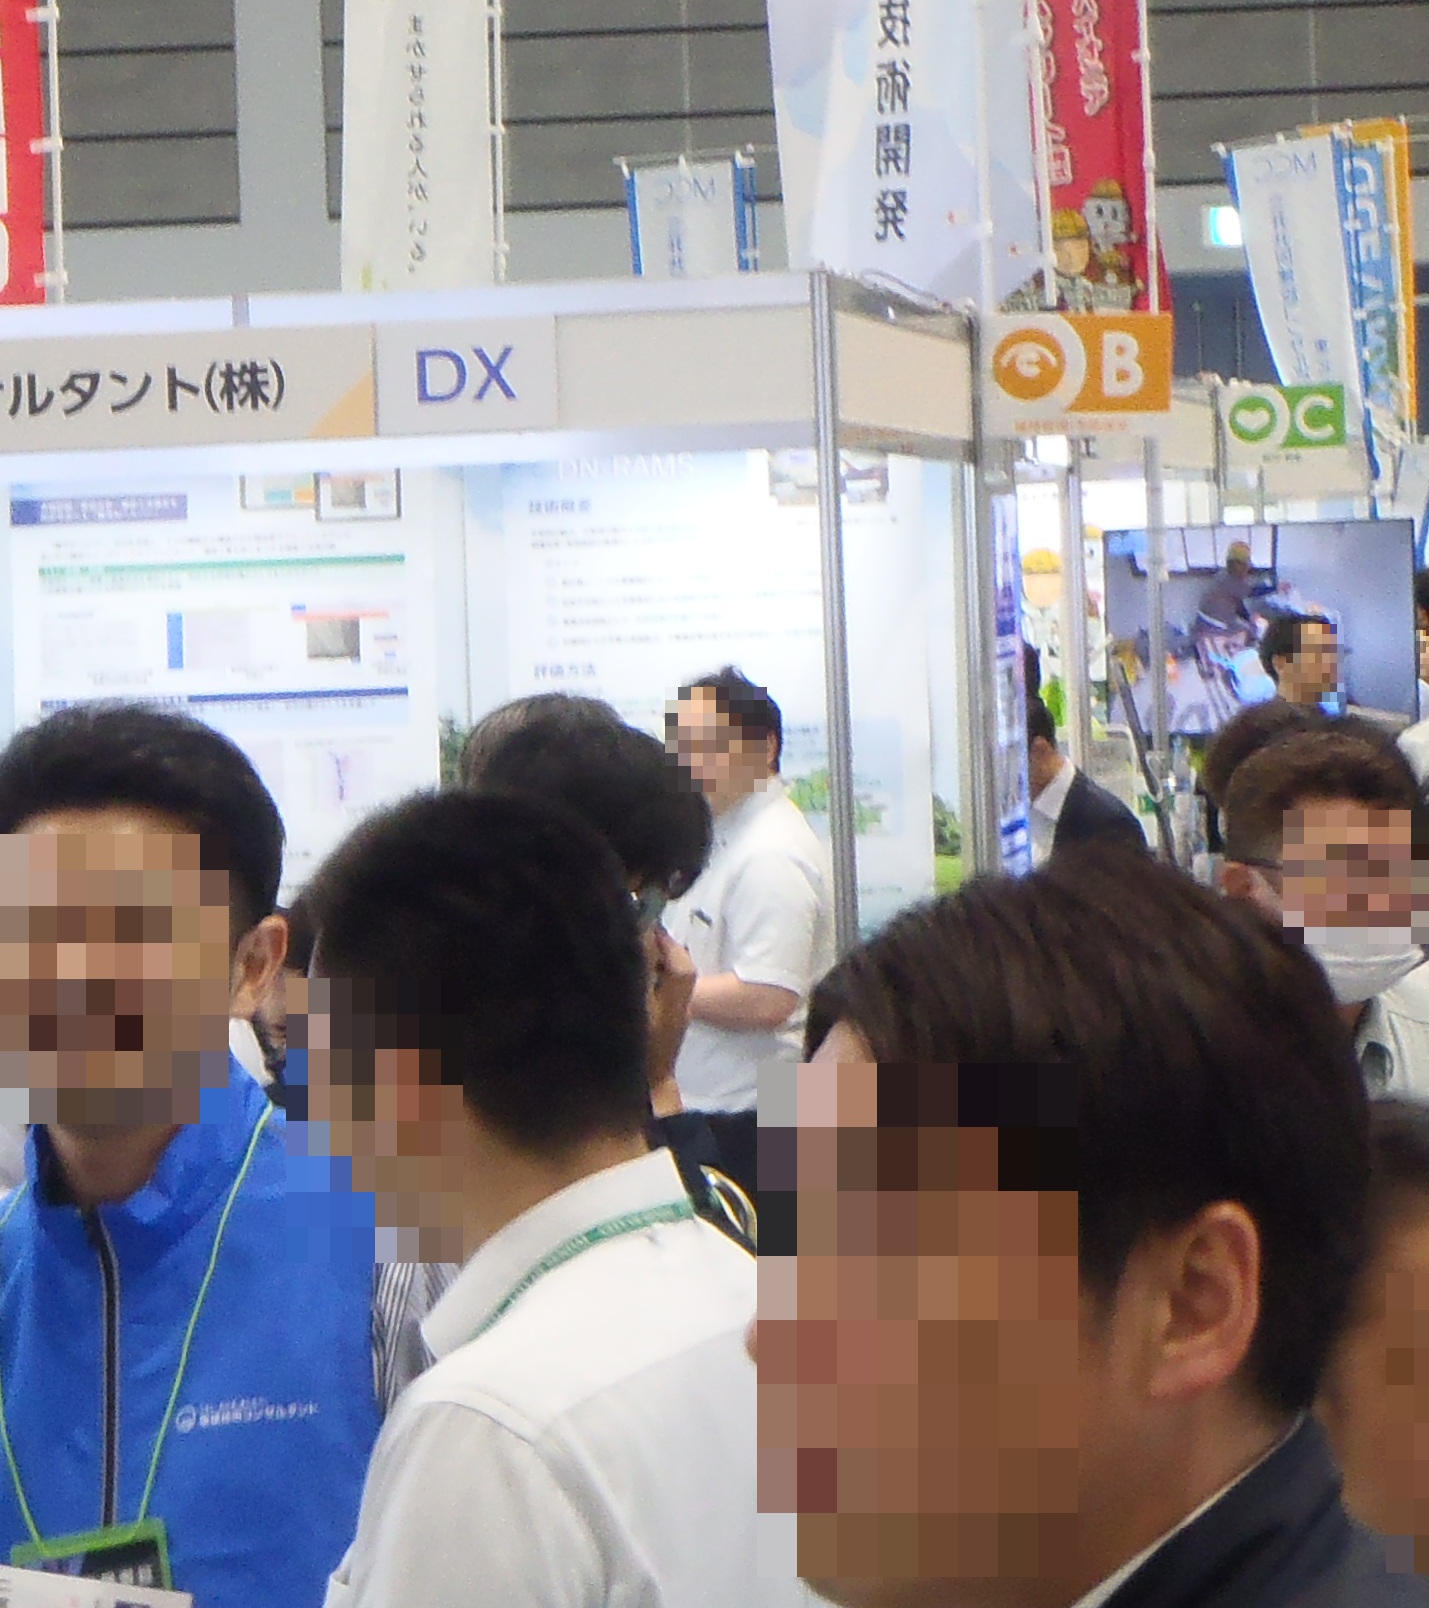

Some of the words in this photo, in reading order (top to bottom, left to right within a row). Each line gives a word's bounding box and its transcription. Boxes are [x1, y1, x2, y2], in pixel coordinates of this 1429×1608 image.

[0, 357, 285, 419] ルタント(株)
[416, 345, 516, 402] DX
[1102, 329, 1144, 398] B
[1294, 394, 1335, 440] C
